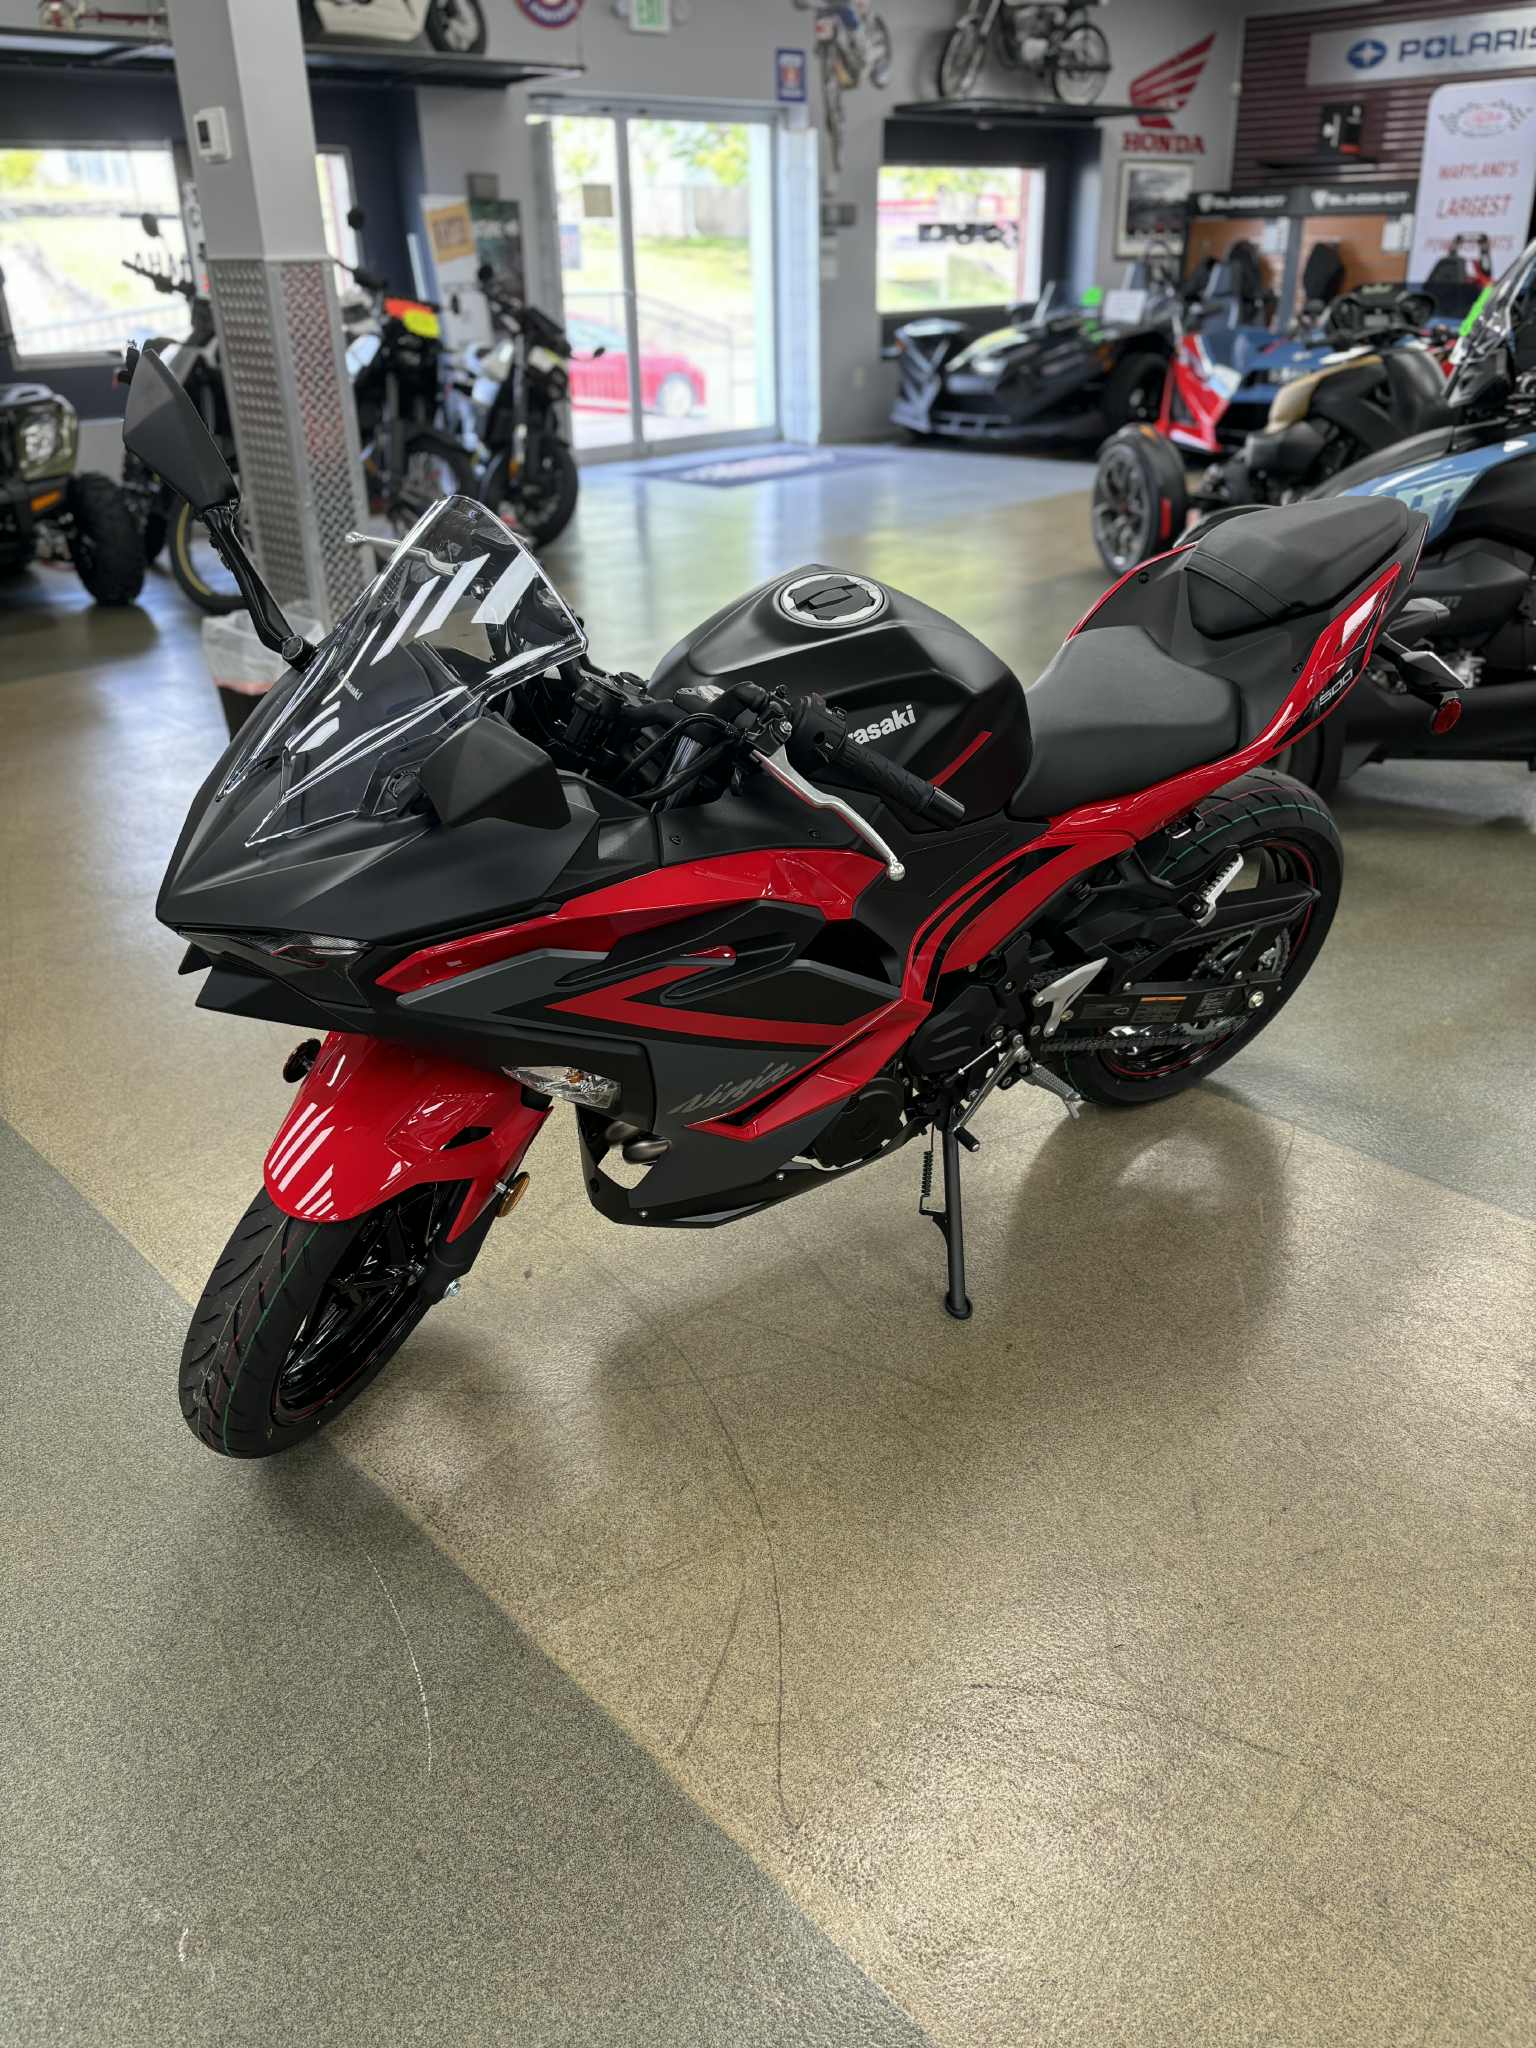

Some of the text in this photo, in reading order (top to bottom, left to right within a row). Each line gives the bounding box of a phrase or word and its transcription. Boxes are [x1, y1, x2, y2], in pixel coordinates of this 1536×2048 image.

[1122, 131, 1206, 154] HONDA
[1436, 193, 1512, 219] LARGEST
[1319, 668, 1353, 706] 500
[847, 704, 916, 745] asaki
